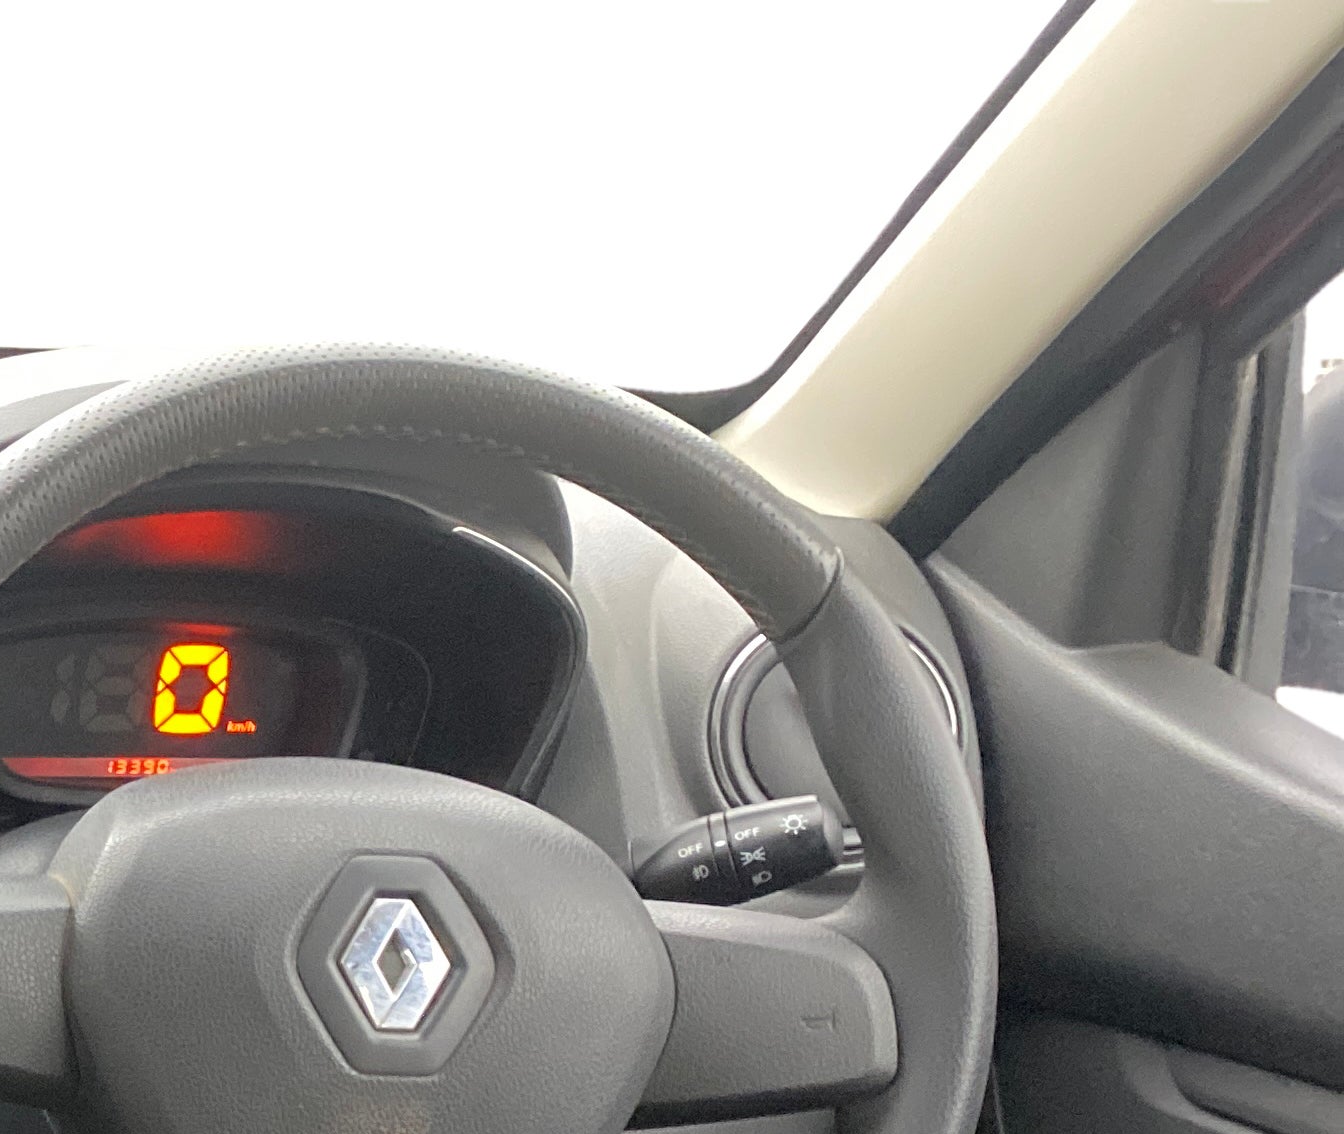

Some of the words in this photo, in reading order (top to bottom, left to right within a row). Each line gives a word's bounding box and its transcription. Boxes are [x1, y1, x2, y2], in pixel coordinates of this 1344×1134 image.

[153, 643, 229, 735] 0
[226, 720, 257, 733] km/h
[734, 826, 761, 841] OFF
[678, 842, 704, 858] OFF
